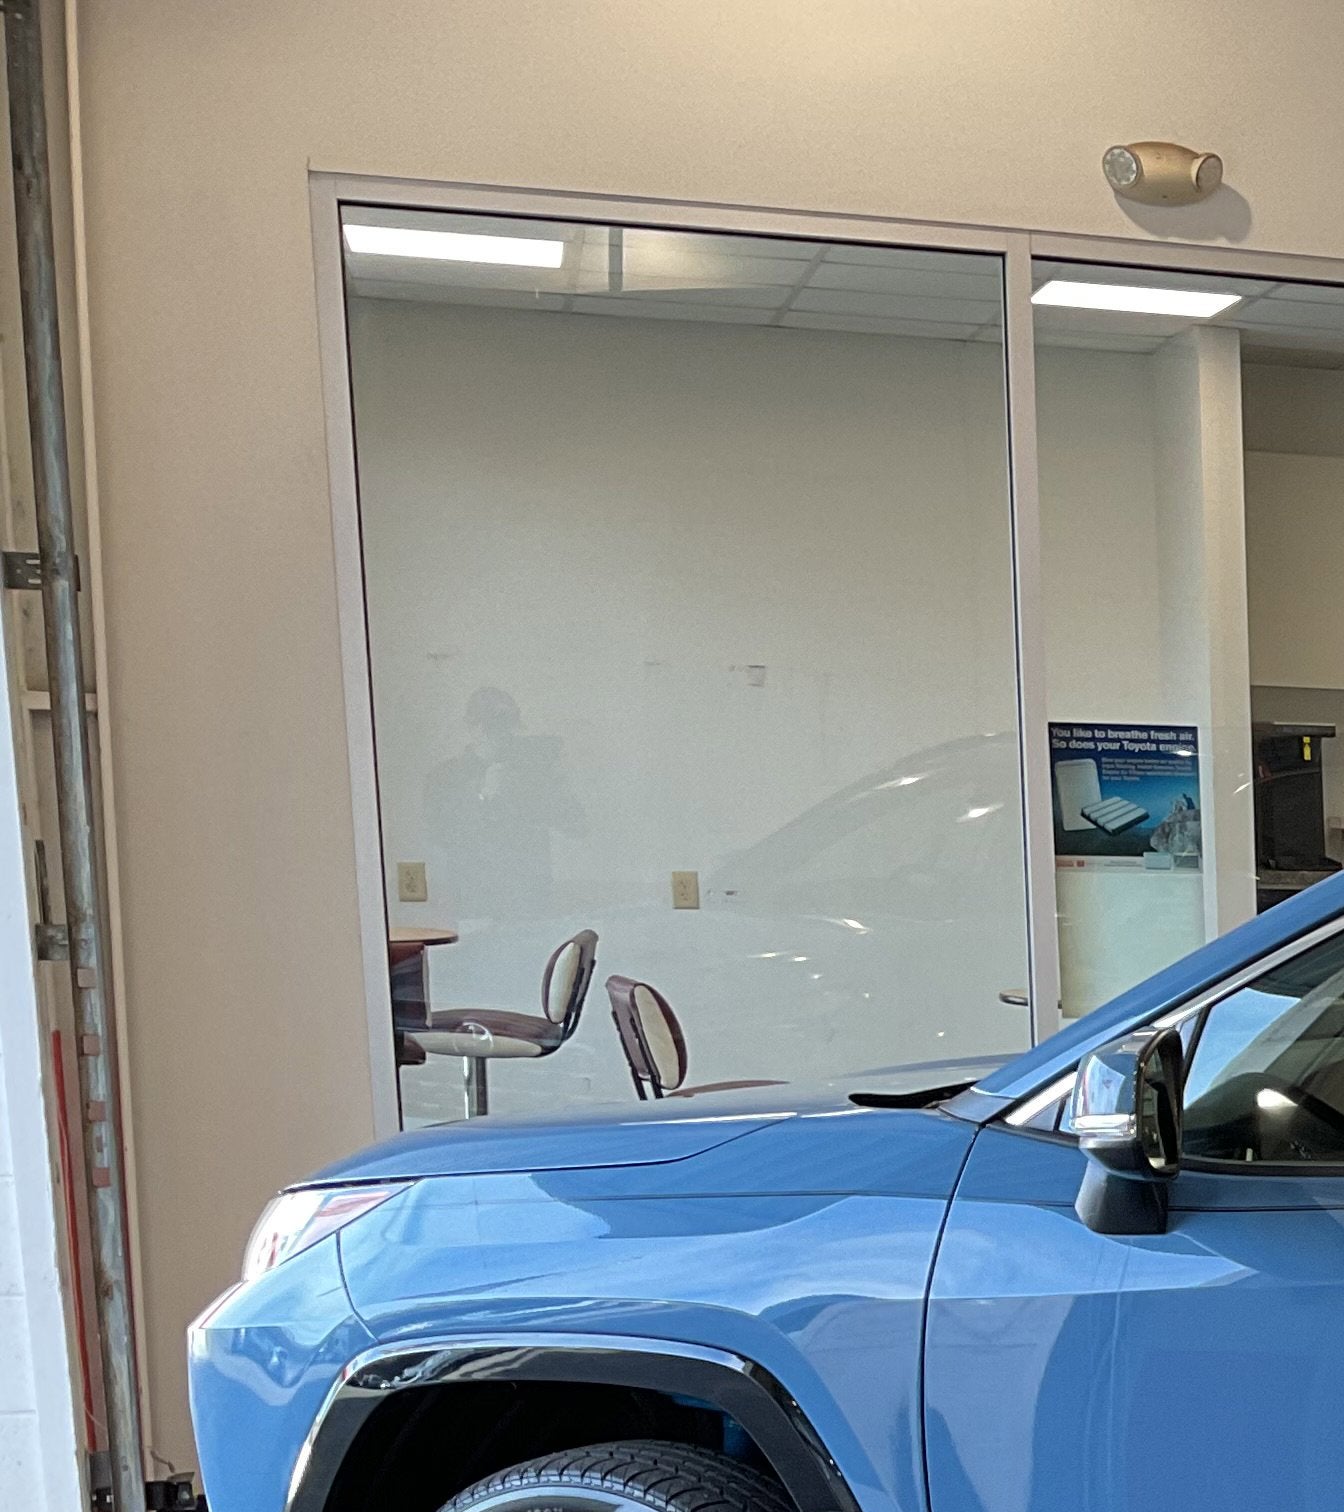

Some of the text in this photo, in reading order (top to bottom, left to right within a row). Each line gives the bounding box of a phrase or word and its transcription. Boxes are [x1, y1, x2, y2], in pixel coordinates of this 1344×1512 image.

[1050, 727, 1070, 738] You
[1073, 728, 1092, 738] like
[1094, 729, 1106, 739] to
[1107, 729, 1148, 740] breathe
[1150, 730, 1177, 741] fresh
[1052, 739, 1067, 749] So
[1069, 739, 1095, 750] does
[1097, 741, 1121, 752] your
[1121, 741, 1158, 753] Toyota
